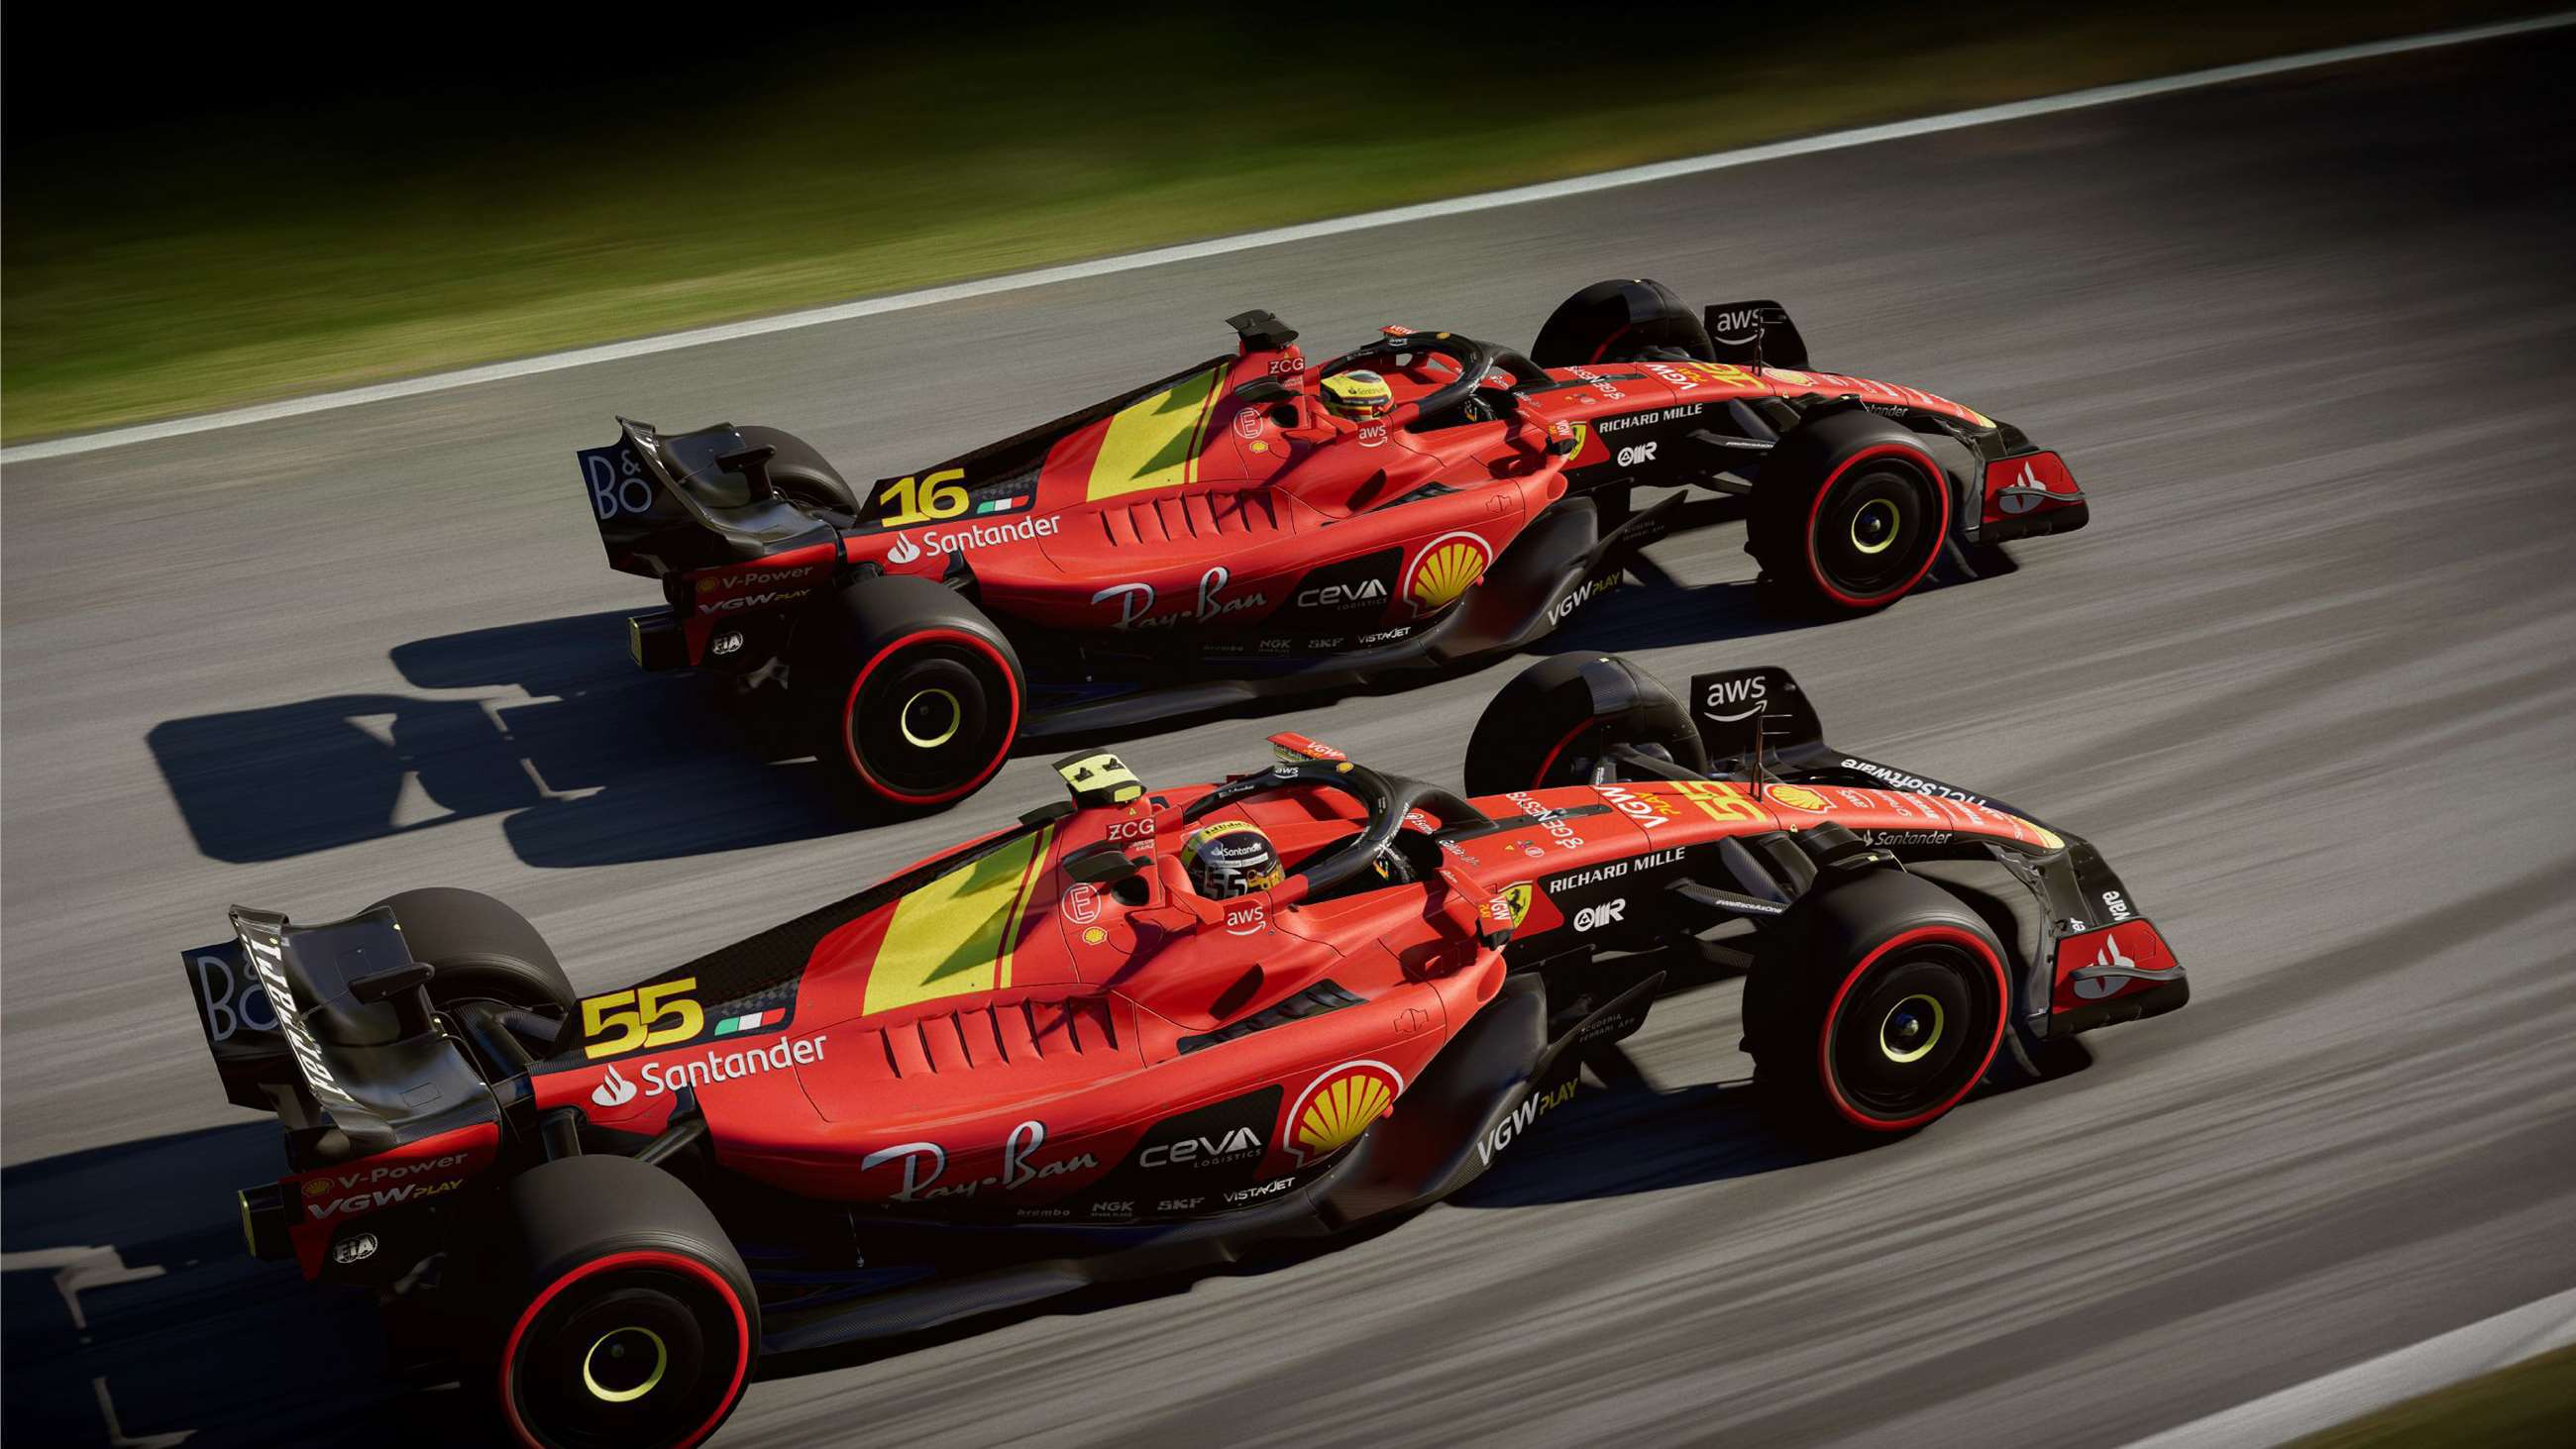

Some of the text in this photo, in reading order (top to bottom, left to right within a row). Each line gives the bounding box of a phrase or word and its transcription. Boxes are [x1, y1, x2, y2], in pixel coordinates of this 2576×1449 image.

[1717, 309, 1762, 332] aws
[1270, 359, 1304, 374] ZCG
[1645, 363, 1699, 390] VGW
[1599, 403, 1704, 434] RICHARD MILLE
[1869, 404, 1909, 417] tander
[1358, 424, 1386, 440] aws
[588, 449, 654, 521] B&O
[879, 467, 970, 528] 16
[923, 515, 1061, 557] Santander
[721, 566, 813, 589] V-Power
[697, 592, 777, 615] VGW
[1091, 567, 1267, 630] Ray-Ban
[1547, 571, 1621, 627] VGW PLAY
[712, 634, 742, 655] FIA
[1707, 675, 1768, 707] aws
[1275, 767, 1299, 776] aws
[1594, 785, 1669, 829] VGW
[1635, 791, 1681, 815] PLAY
[1667, 779, 1769, 823] 55
[1109, 818, 1155, 842] ZCG
[1875, 830, 1953, 847] Santander
[1550, 847, 1685, 893] RICHARD MILLE
[1227, 905, 1264, 927] aws
[1489, 895, 1513, 921] VGW
[582, 977, 704, 1060] 55
[641, 1035, 827, 1096] Santander
[1476, 1077, 1579, 1167] VGW PLAY
[338, 1153, 469, 1189] V-Power
[861, 1120, 1099, 1202] Ray-Ban
[1193, 1148, 1262, 1169] LOGISTICS
[308, 1179, 464, 1219] VGW PLAY
[1092, 1200, 1134, 1212] NGK
[1157, 1196, 1206, 1211] SKF
[335, 1235, 376, 1262] FIA
